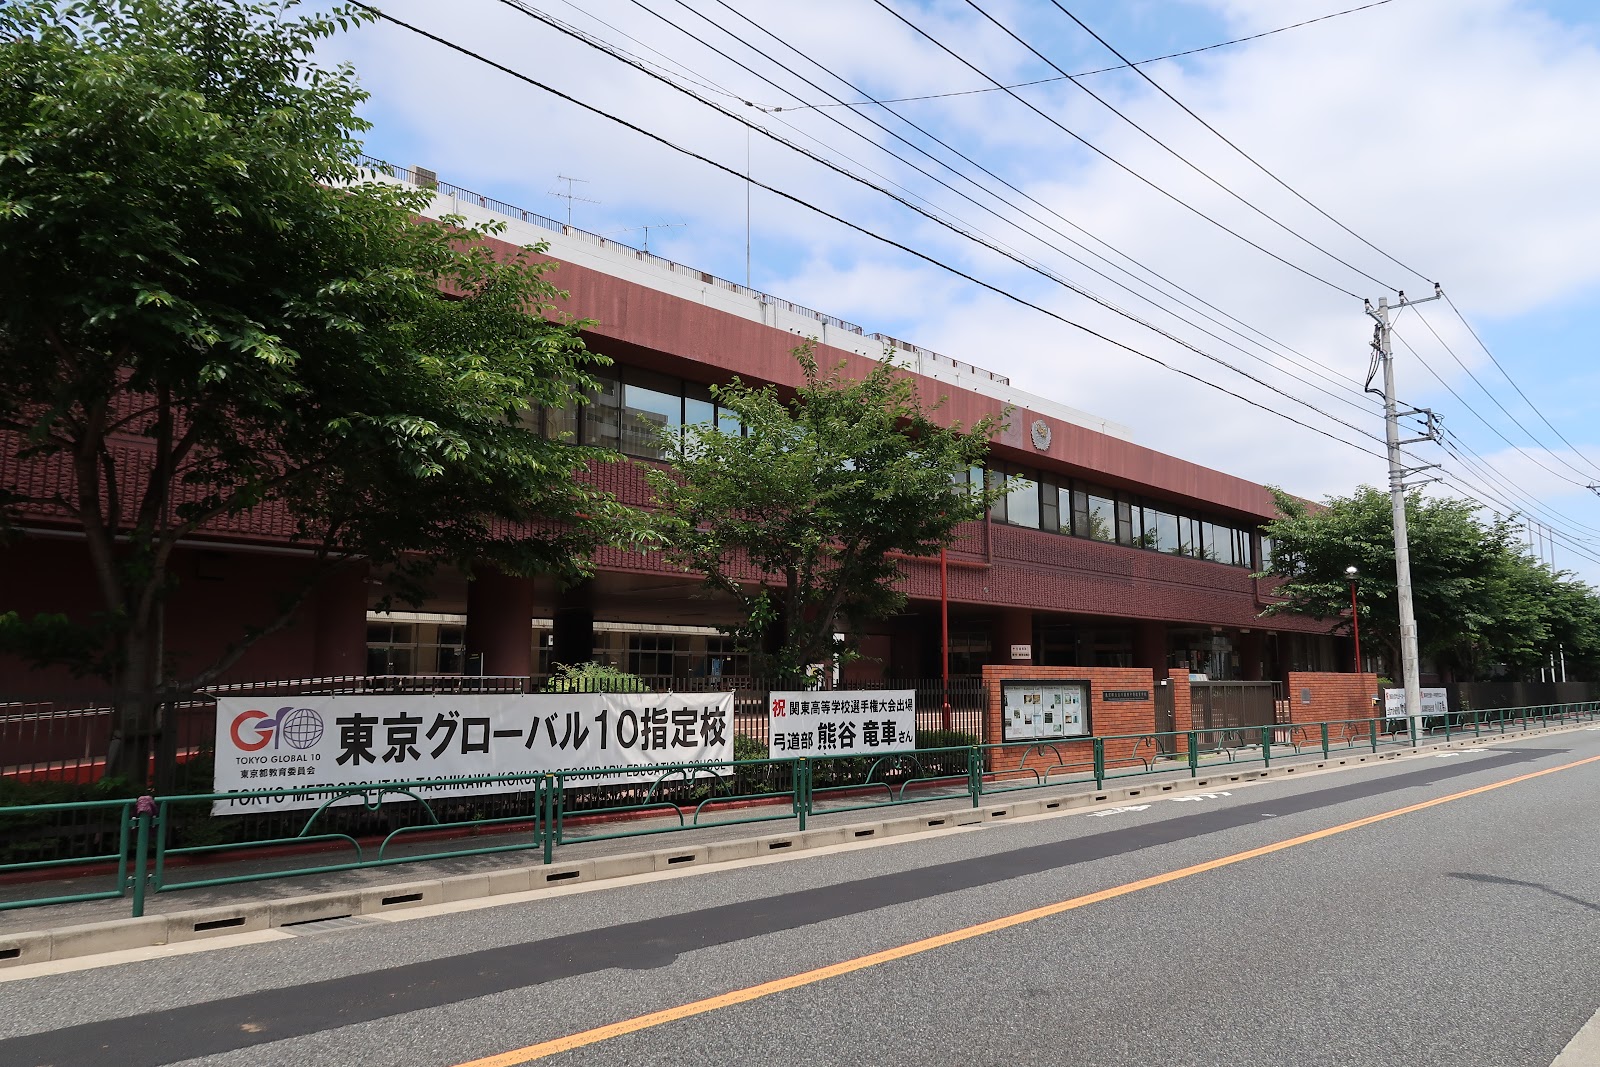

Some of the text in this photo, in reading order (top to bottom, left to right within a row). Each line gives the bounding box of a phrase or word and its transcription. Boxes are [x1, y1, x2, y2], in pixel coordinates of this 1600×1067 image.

[772, 698, 913, 717] 祝 関東高等学校選手権大会出場
[335, 705, 726, 767] 東京グローバル10指定校
[773, 731, 814, 751] 弓道部
[817, 721, 857, 750] 熊谷
[235, 753, 321, 765] TOKYO GLOBAL 10
[240, 765, 316, 779] 東京都教育委員会
[227, 786, 285, 807] TOKYO
